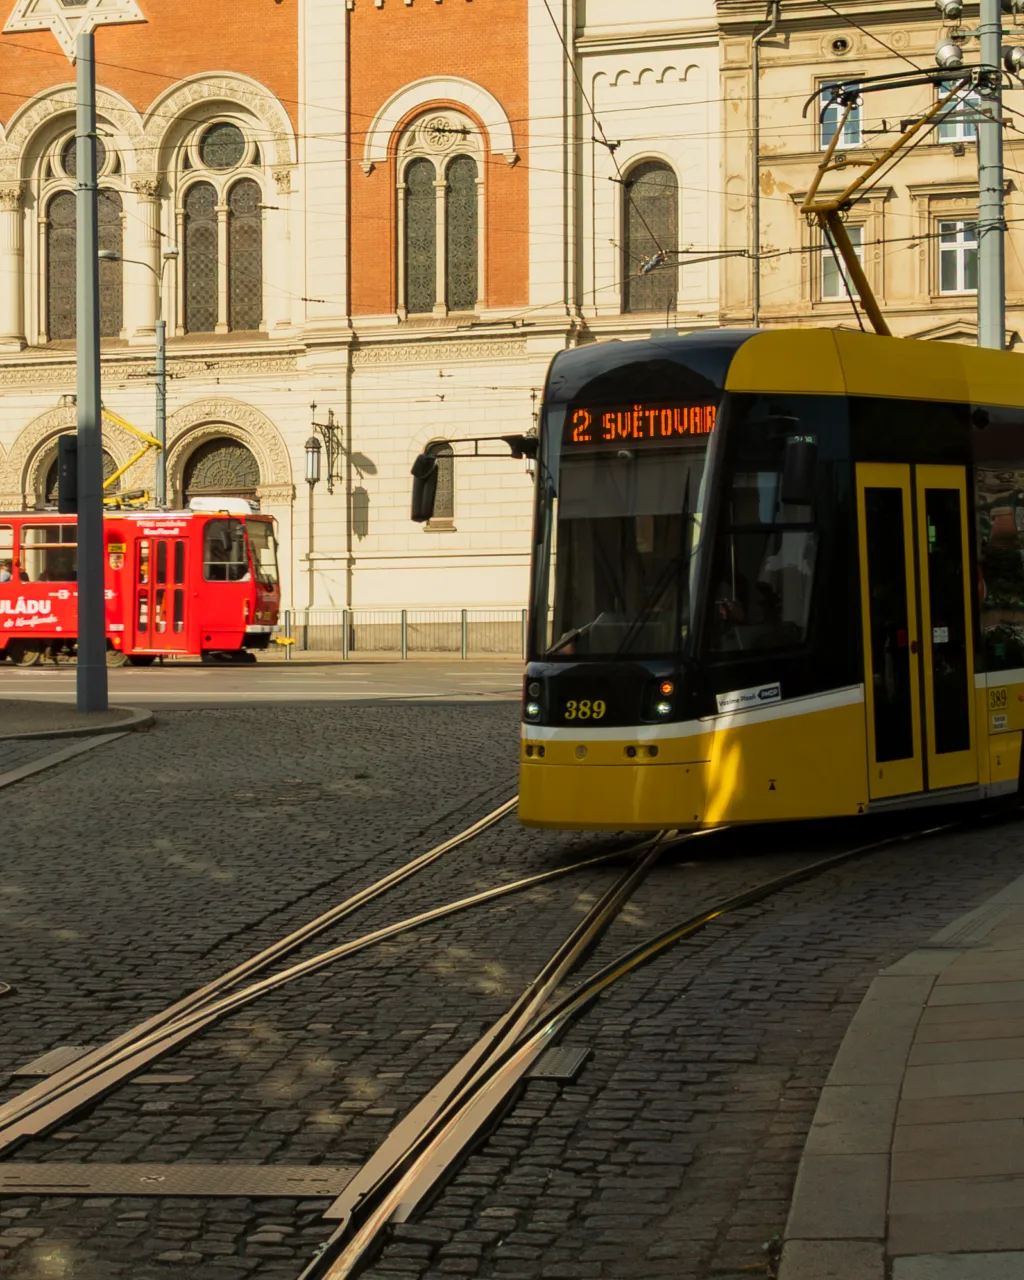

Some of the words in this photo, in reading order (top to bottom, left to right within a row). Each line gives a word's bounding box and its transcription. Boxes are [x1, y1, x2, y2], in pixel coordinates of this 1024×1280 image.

[572, 407, 592, 442] 2
[990, 688, 1007, 708] 389
[564, 699, 606, 720] 389
